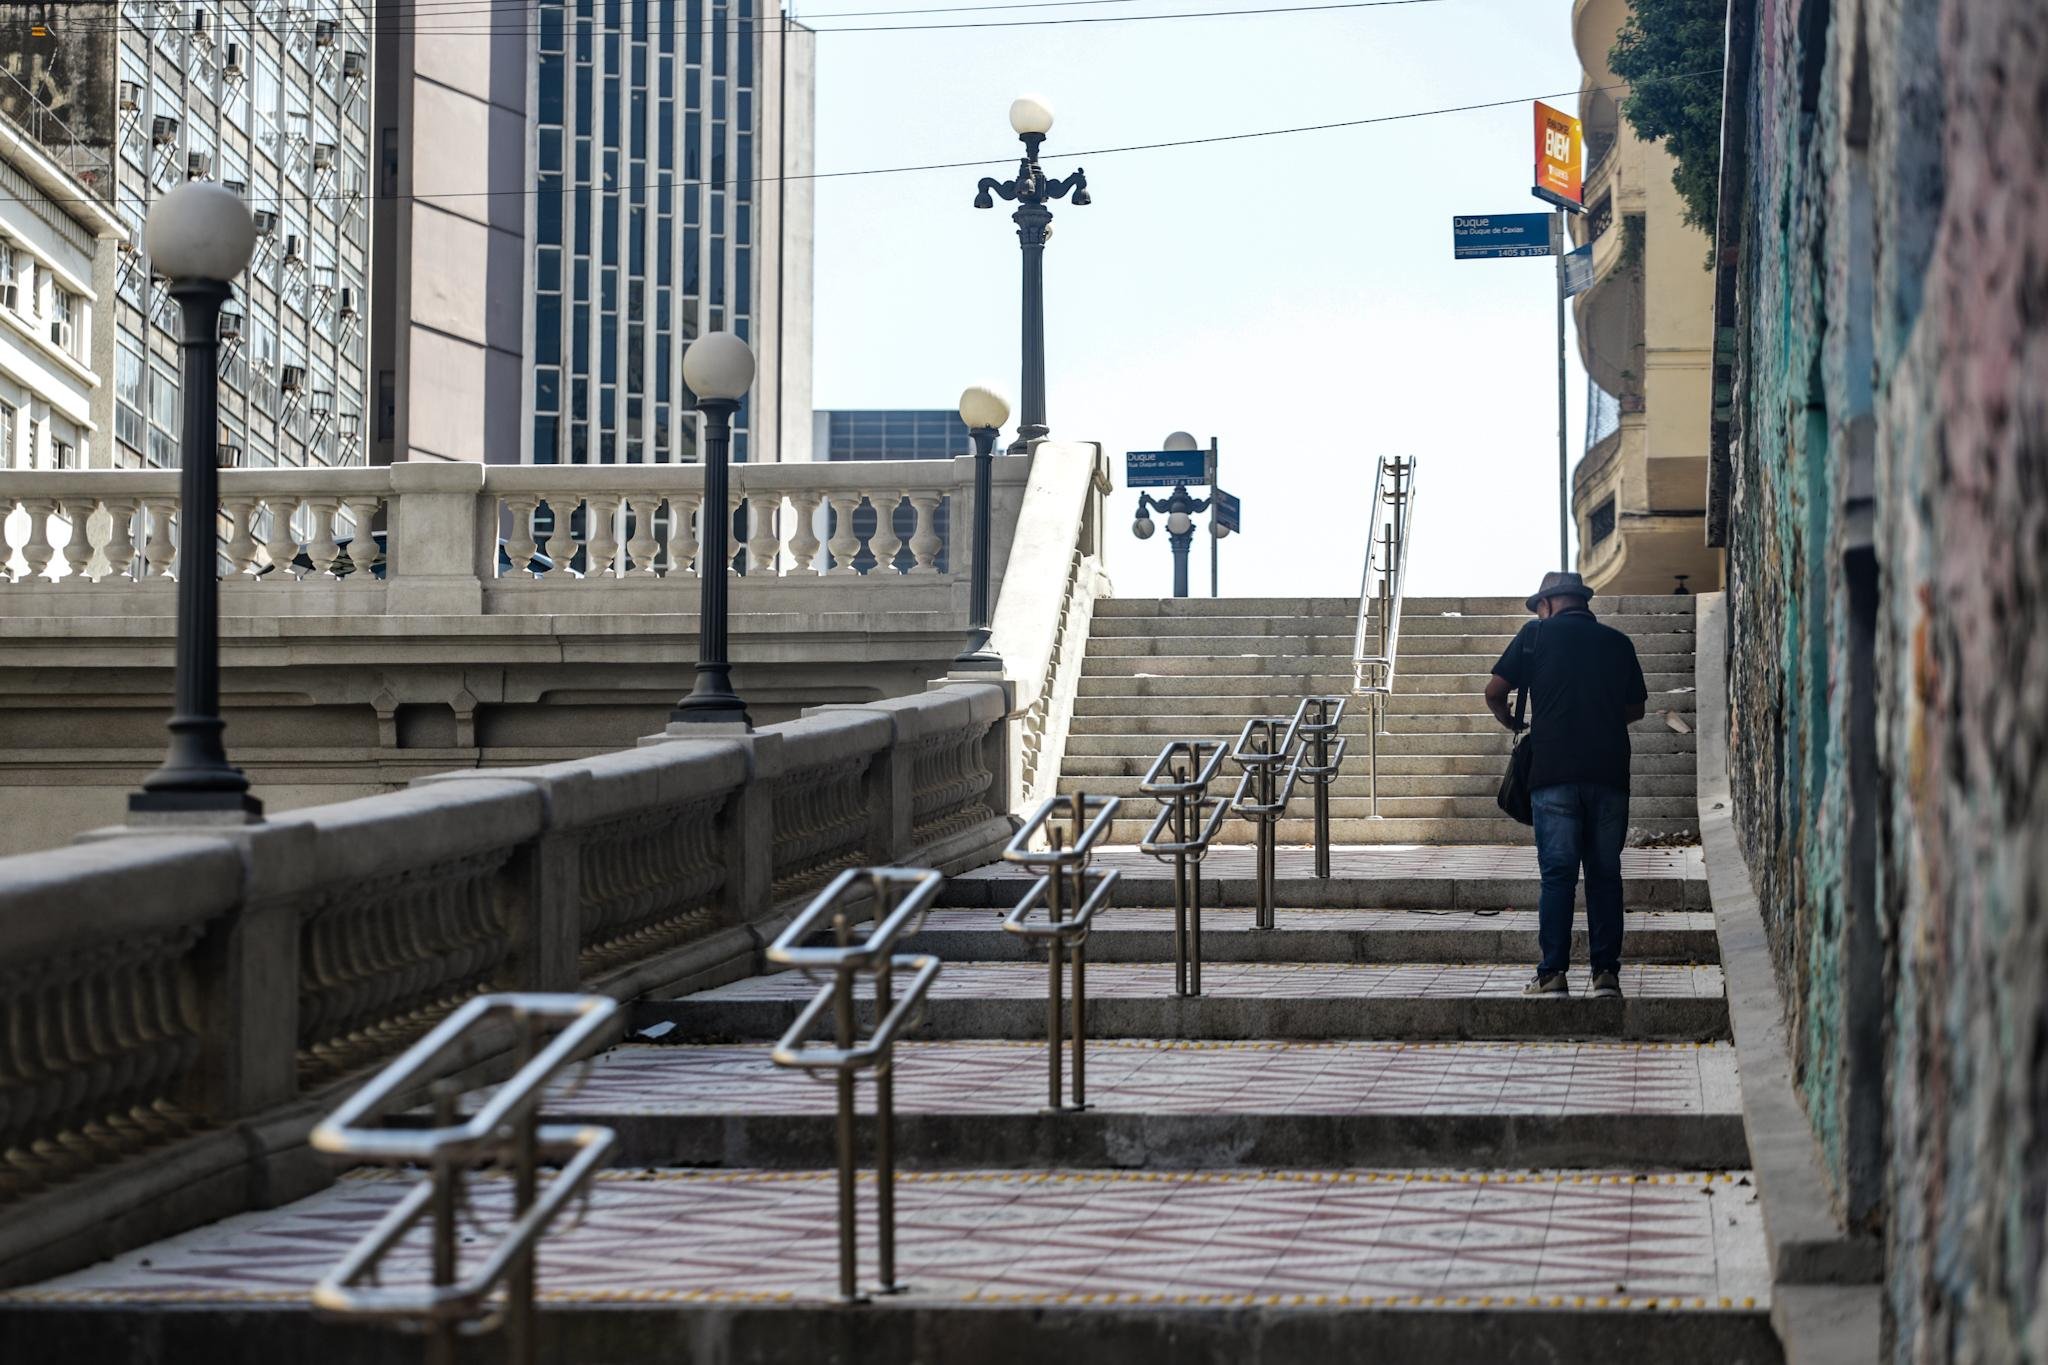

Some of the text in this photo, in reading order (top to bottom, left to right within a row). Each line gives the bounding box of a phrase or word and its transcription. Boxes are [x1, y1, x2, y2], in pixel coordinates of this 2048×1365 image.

[1454, 217, 1489, 229] Duque
[1469, 228, 1491, 236] Duque
[1498, 249, 1518, 257] 1405
[1127, 453, 1156, 462] Duque
